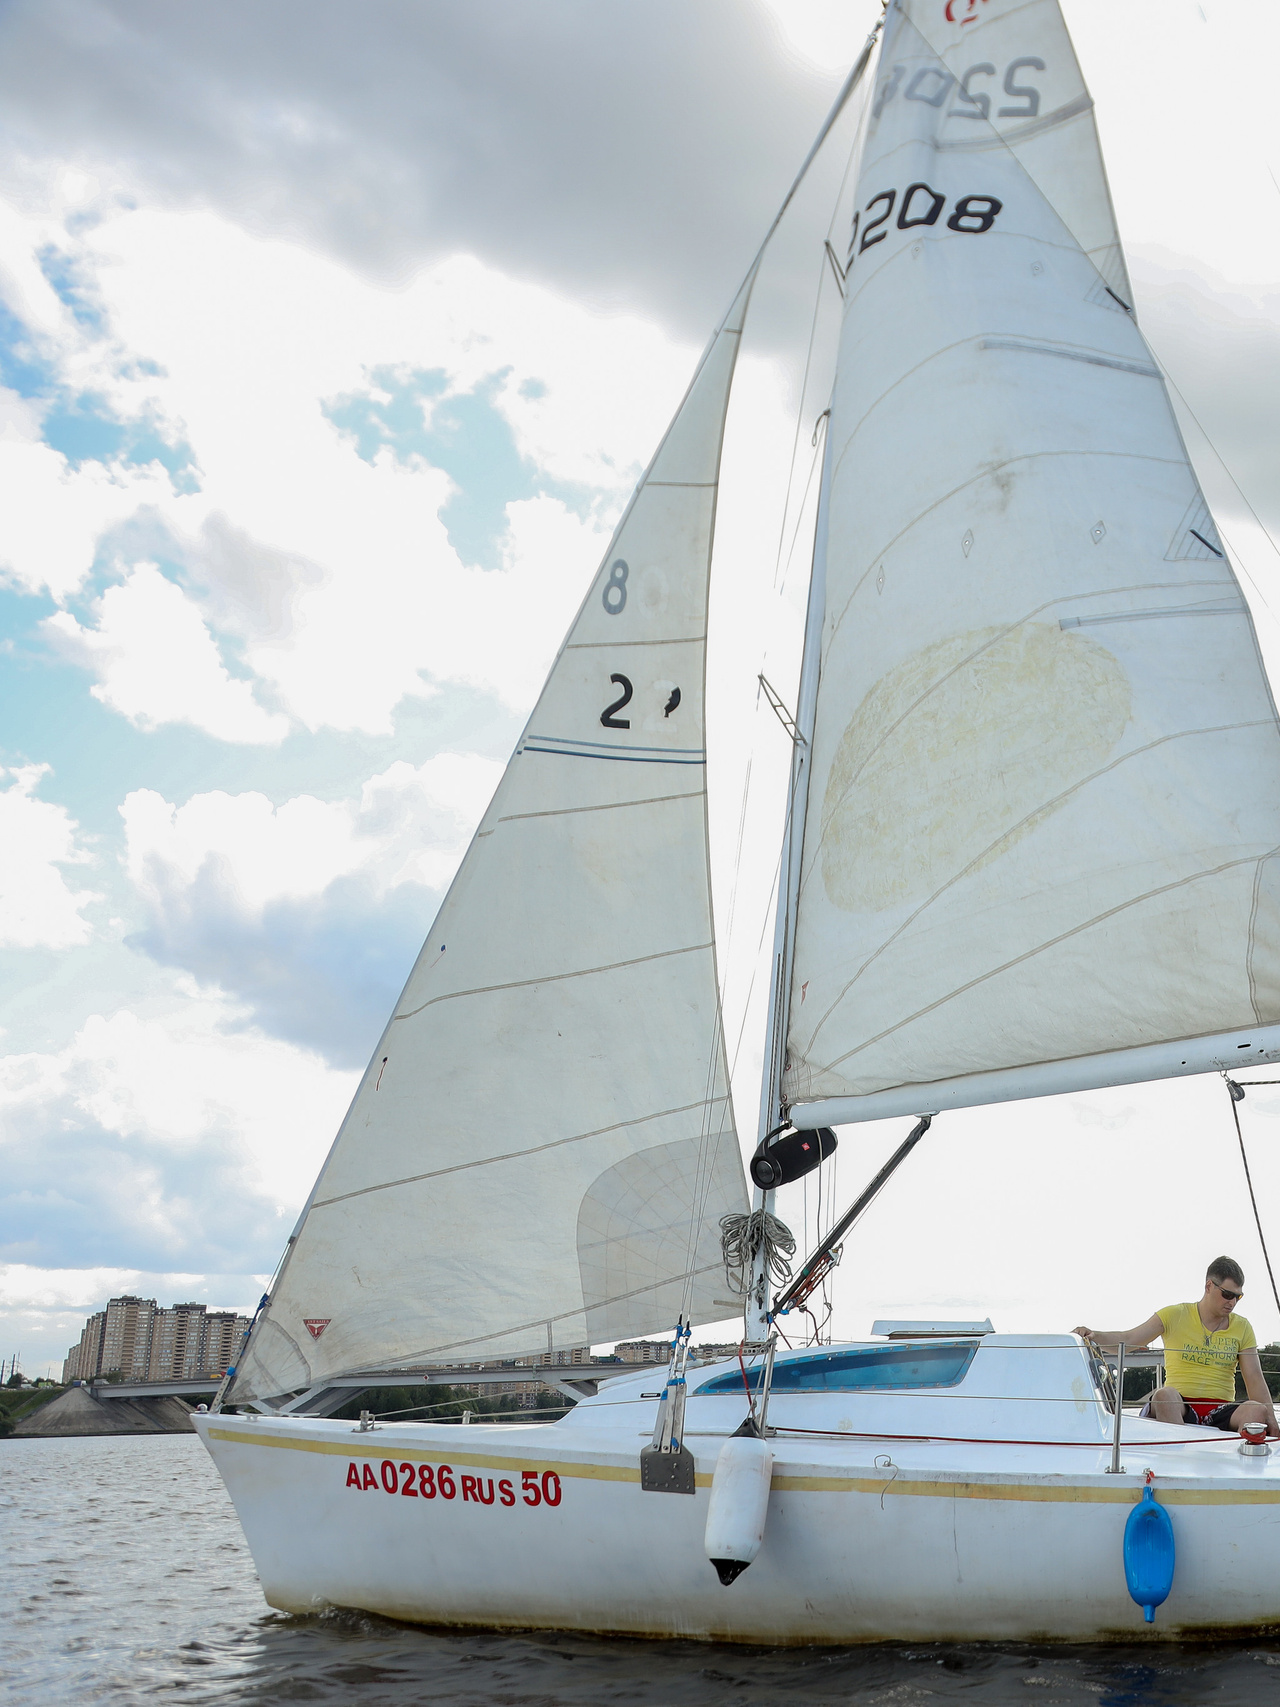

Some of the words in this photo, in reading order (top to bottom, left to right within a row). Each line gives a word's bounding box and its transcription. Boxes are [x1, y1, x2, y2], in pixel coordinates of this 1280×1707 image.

[602, 558, 629, 615] 8
[1182, 1353, 1210, 1366] RACE
[1183, 1343, 1236, 1361] WARRIORS
[346, 1460, 457, 1500] AA0286
[461, 1474, 516, 1507] RUS
[521, 1470, 562, 1507] 50
